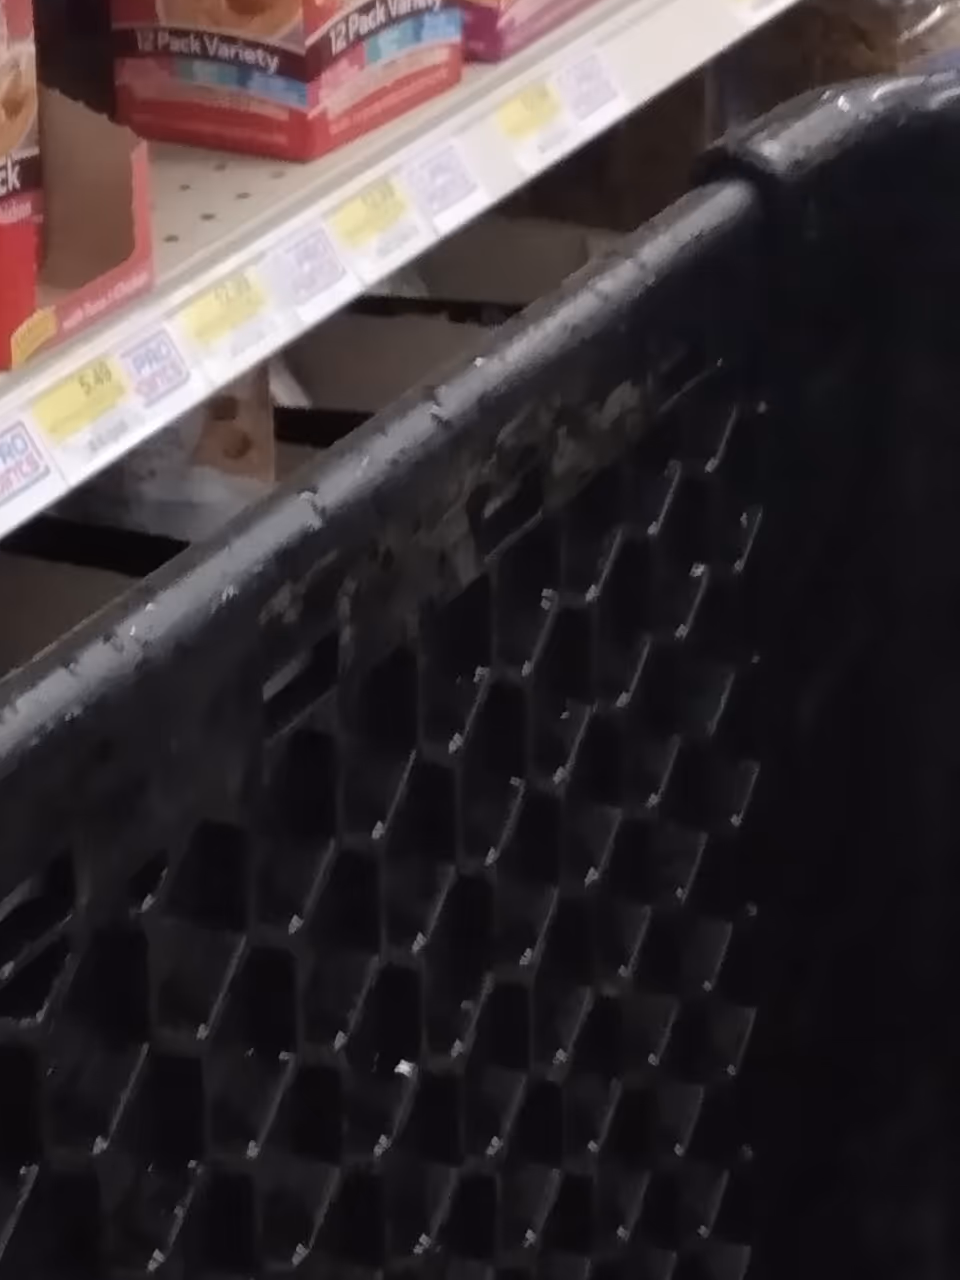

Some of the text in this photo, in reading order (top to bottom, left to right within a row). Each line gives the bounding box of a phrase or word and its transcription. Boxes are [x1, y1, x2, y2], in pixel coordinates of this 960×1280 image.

[157, 28, 201, 56] Pack
[203, 32, 280, 75] Variety
[328, 27, 346, 57] 12
[347, 3, 386, 43] Pack
[130, 335, 173, 376] PRO
